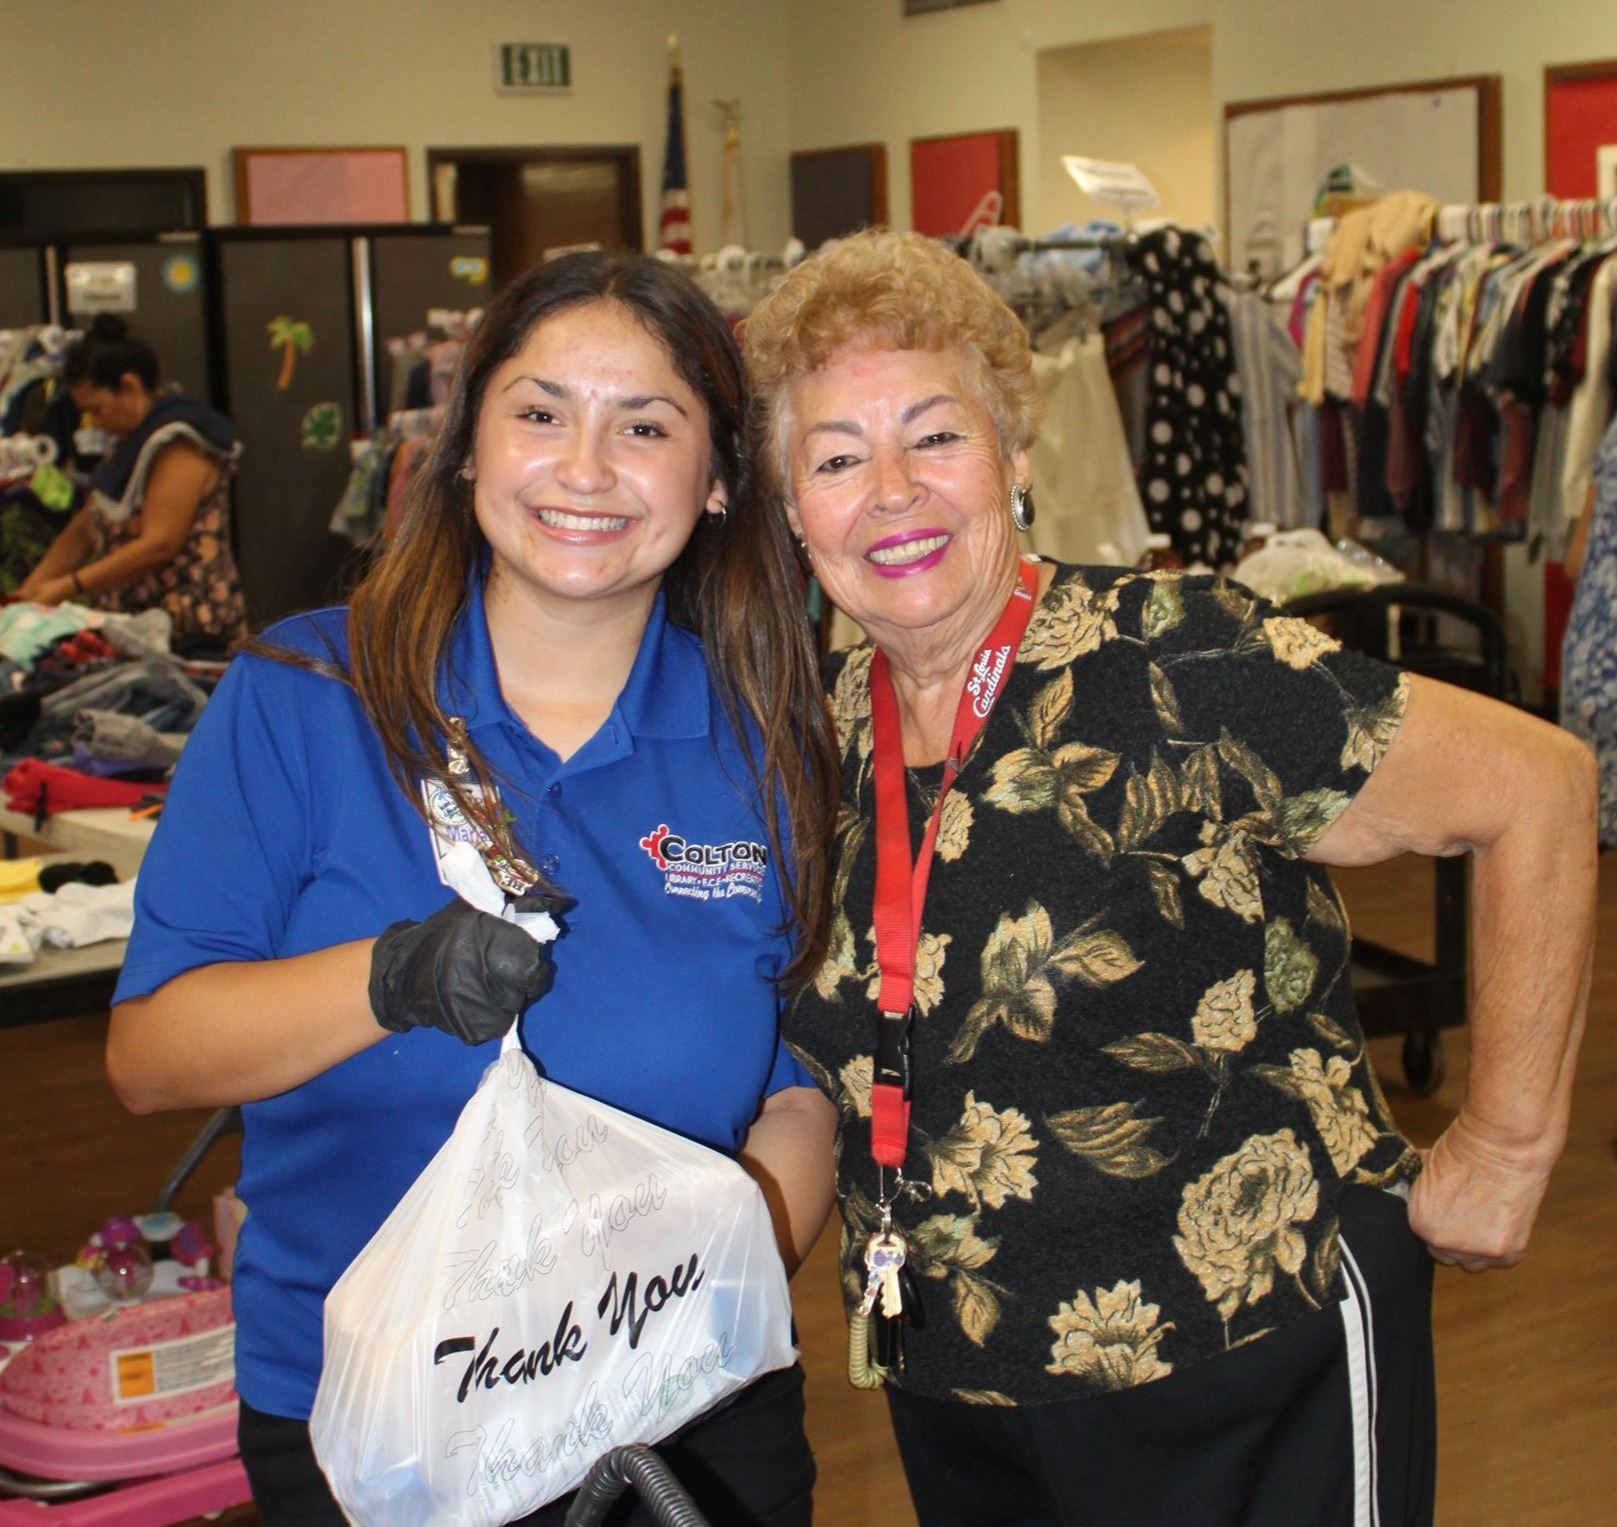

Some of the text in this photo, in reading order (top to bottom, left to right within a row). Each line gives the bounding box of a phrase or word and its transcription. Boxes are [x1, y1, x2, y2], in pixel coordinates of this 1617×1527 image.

[511, 46, 561, 86] EXIT
[973, 645, 1011, 718] Cardinals
[974, 649, 992, 682] Louis
[668, 864, 728, 876] COMMUNITY
[561, 1173, 667, 1271] You
[434, 1253, 705, 1403] Thank You
[445, 1331, 735, 1497] Thank You
